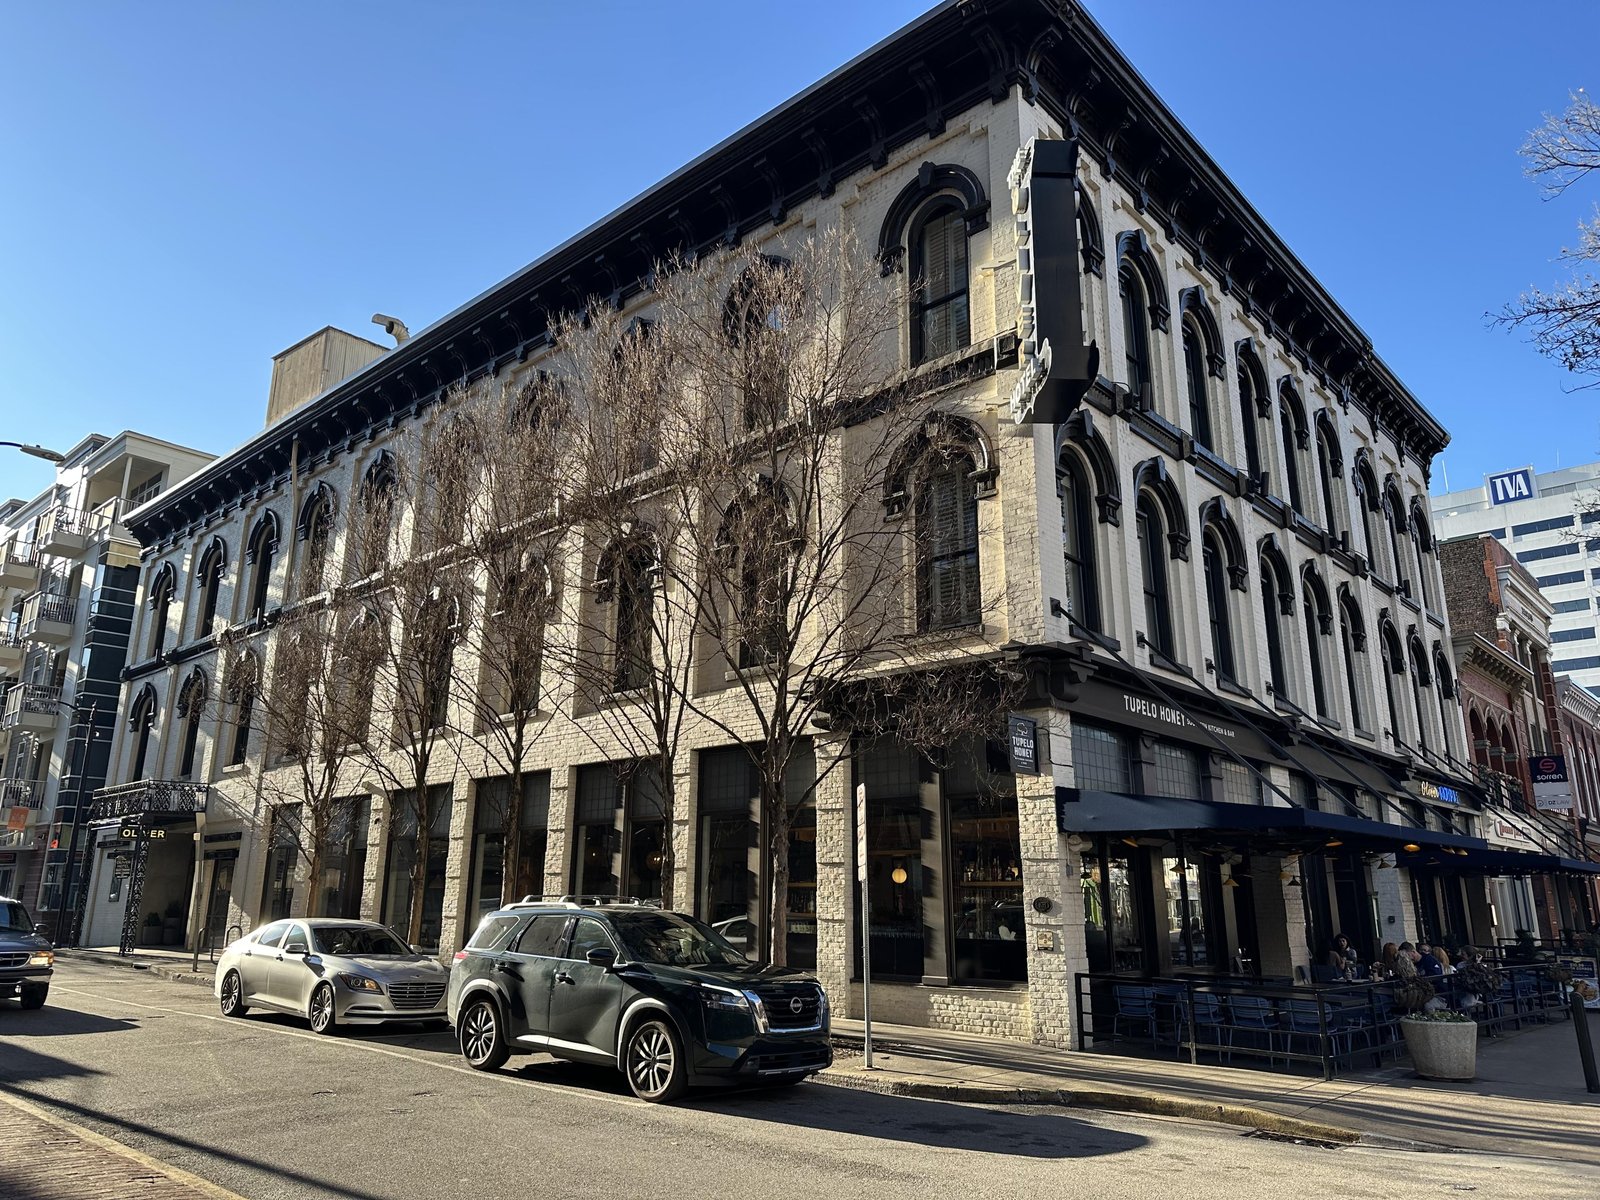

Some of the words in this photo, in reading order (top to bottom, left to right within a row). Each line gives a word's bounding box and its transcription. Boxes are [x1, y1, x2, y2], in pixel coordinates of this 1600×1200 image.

[1010, 357, 1036, 414] HOTEL
[1492, 474, 1529, 500] TVA
[1123, 694, 1157, 719] TUPELO
[1160, 705, 1185, 727] HONEY
[1012, 735, 1034, 749] TUPELO
[1014, 746, 1033, 759] HONEY
[1536, 773, 1563, 781] sorren
[122, 829, 165, 838] OLVER
